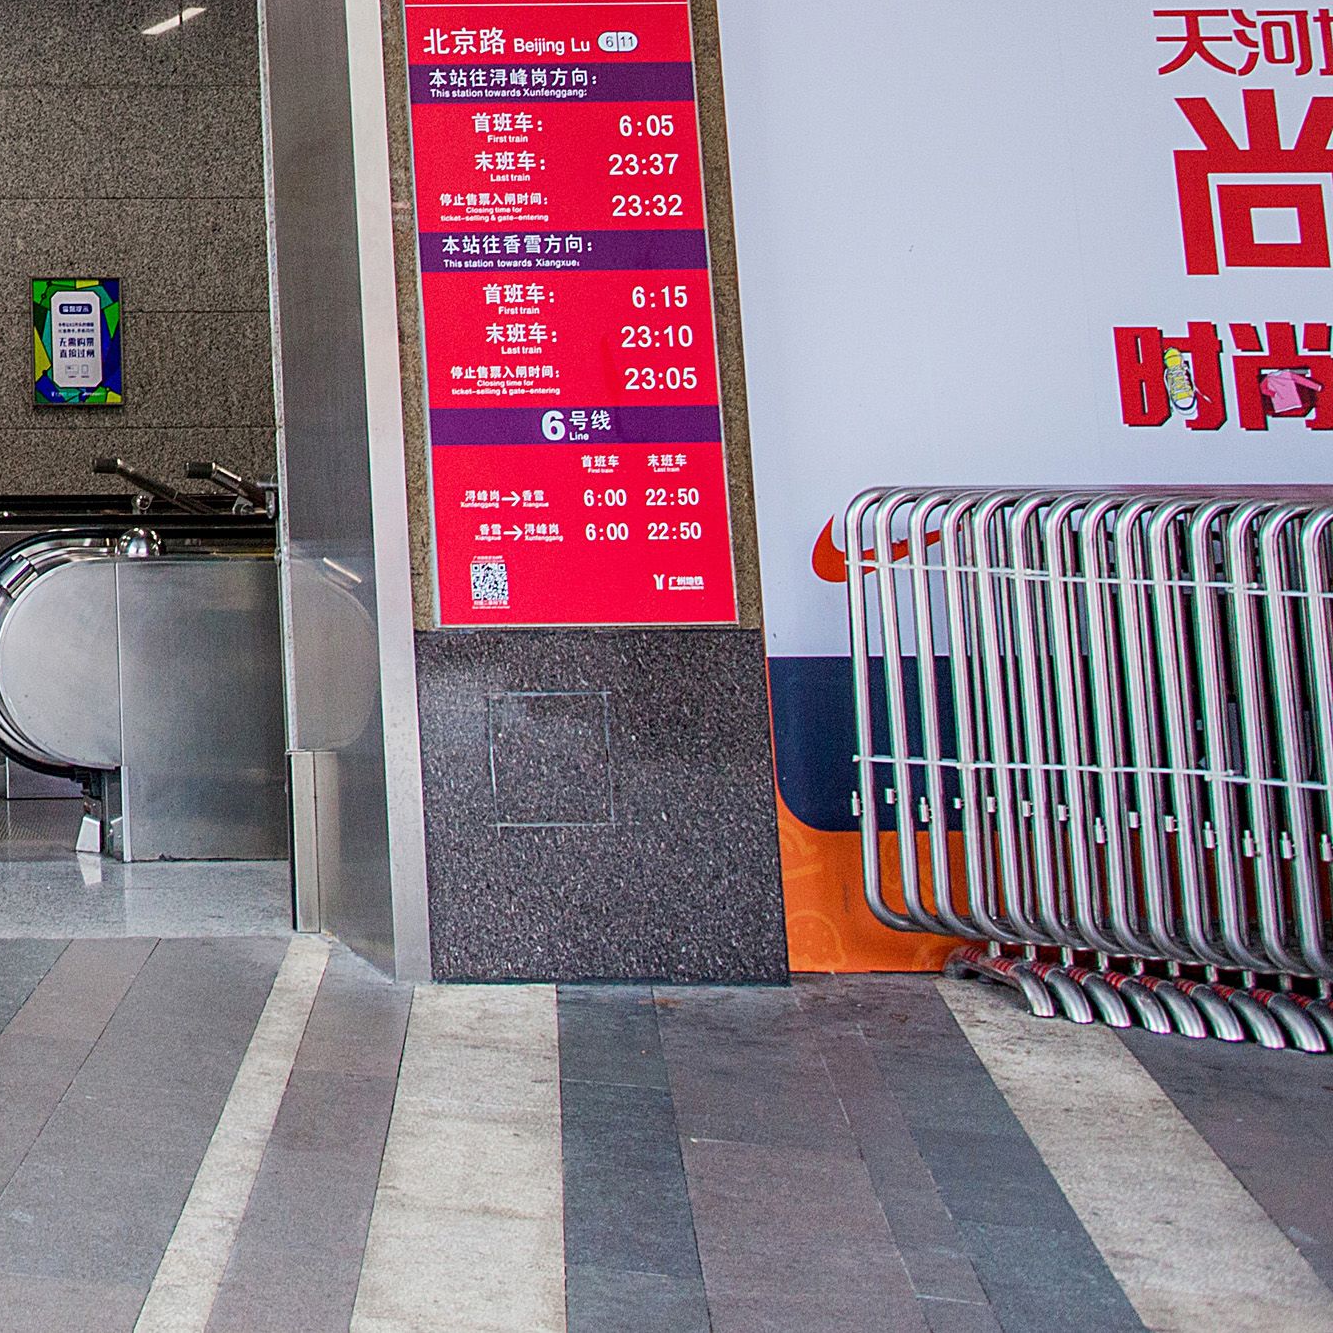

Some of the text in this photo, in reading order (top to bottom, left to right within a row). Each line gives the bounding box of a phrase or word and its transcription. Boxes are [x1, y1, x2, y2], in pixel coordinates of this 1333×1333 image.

[423, 27, 505, 55] 北京路
[514, 37, 565, 56] Beijing
[571, 37, 590, 52] Lu
[1152, 8, 1333, 77] 天河
[429, 68, 597, 87] 本站往浔峰岗方向：
[430, 89, 450, 97] This
[452, 89, 483, 97] station
[485, 88, 521, 97] towards
[471, 112, 674, 136] 首班车： 6:05
[487, 135, 528, 143] First train
[475, 151, 679, 175] 末班车： 23:37
[490, 173, 530, 182] Last train
[1173, 88, 1333, 276] 尚
[612, 195, 683, 216] 23:32
[442, 234, 593, 254] 本站往香雪方向：
[444, 259, 462, 267] This
[464, 259, 493, 267] station
[497, 258, 532, 267] towards
[483, 283, 688, 308] 首班车： 6:15
[520, 306, 539, 314] train
[485, 322, 693, 348] 末班车： 23:10
[501, 346, 542, 354] Last train
[624, 367, 697, 390] 23:05
[1113, 321, 1333, 432] 时尚
[569, 432, 589, 441] Line
[581, 454, 687, 467] 首班车 末班车
[583, 489, 627, 507] 6:00
[645, 488, 699, 506] 22:50
[585, 523, 628, 541] 6:00
[647, 522, 702, 540] 22:50
